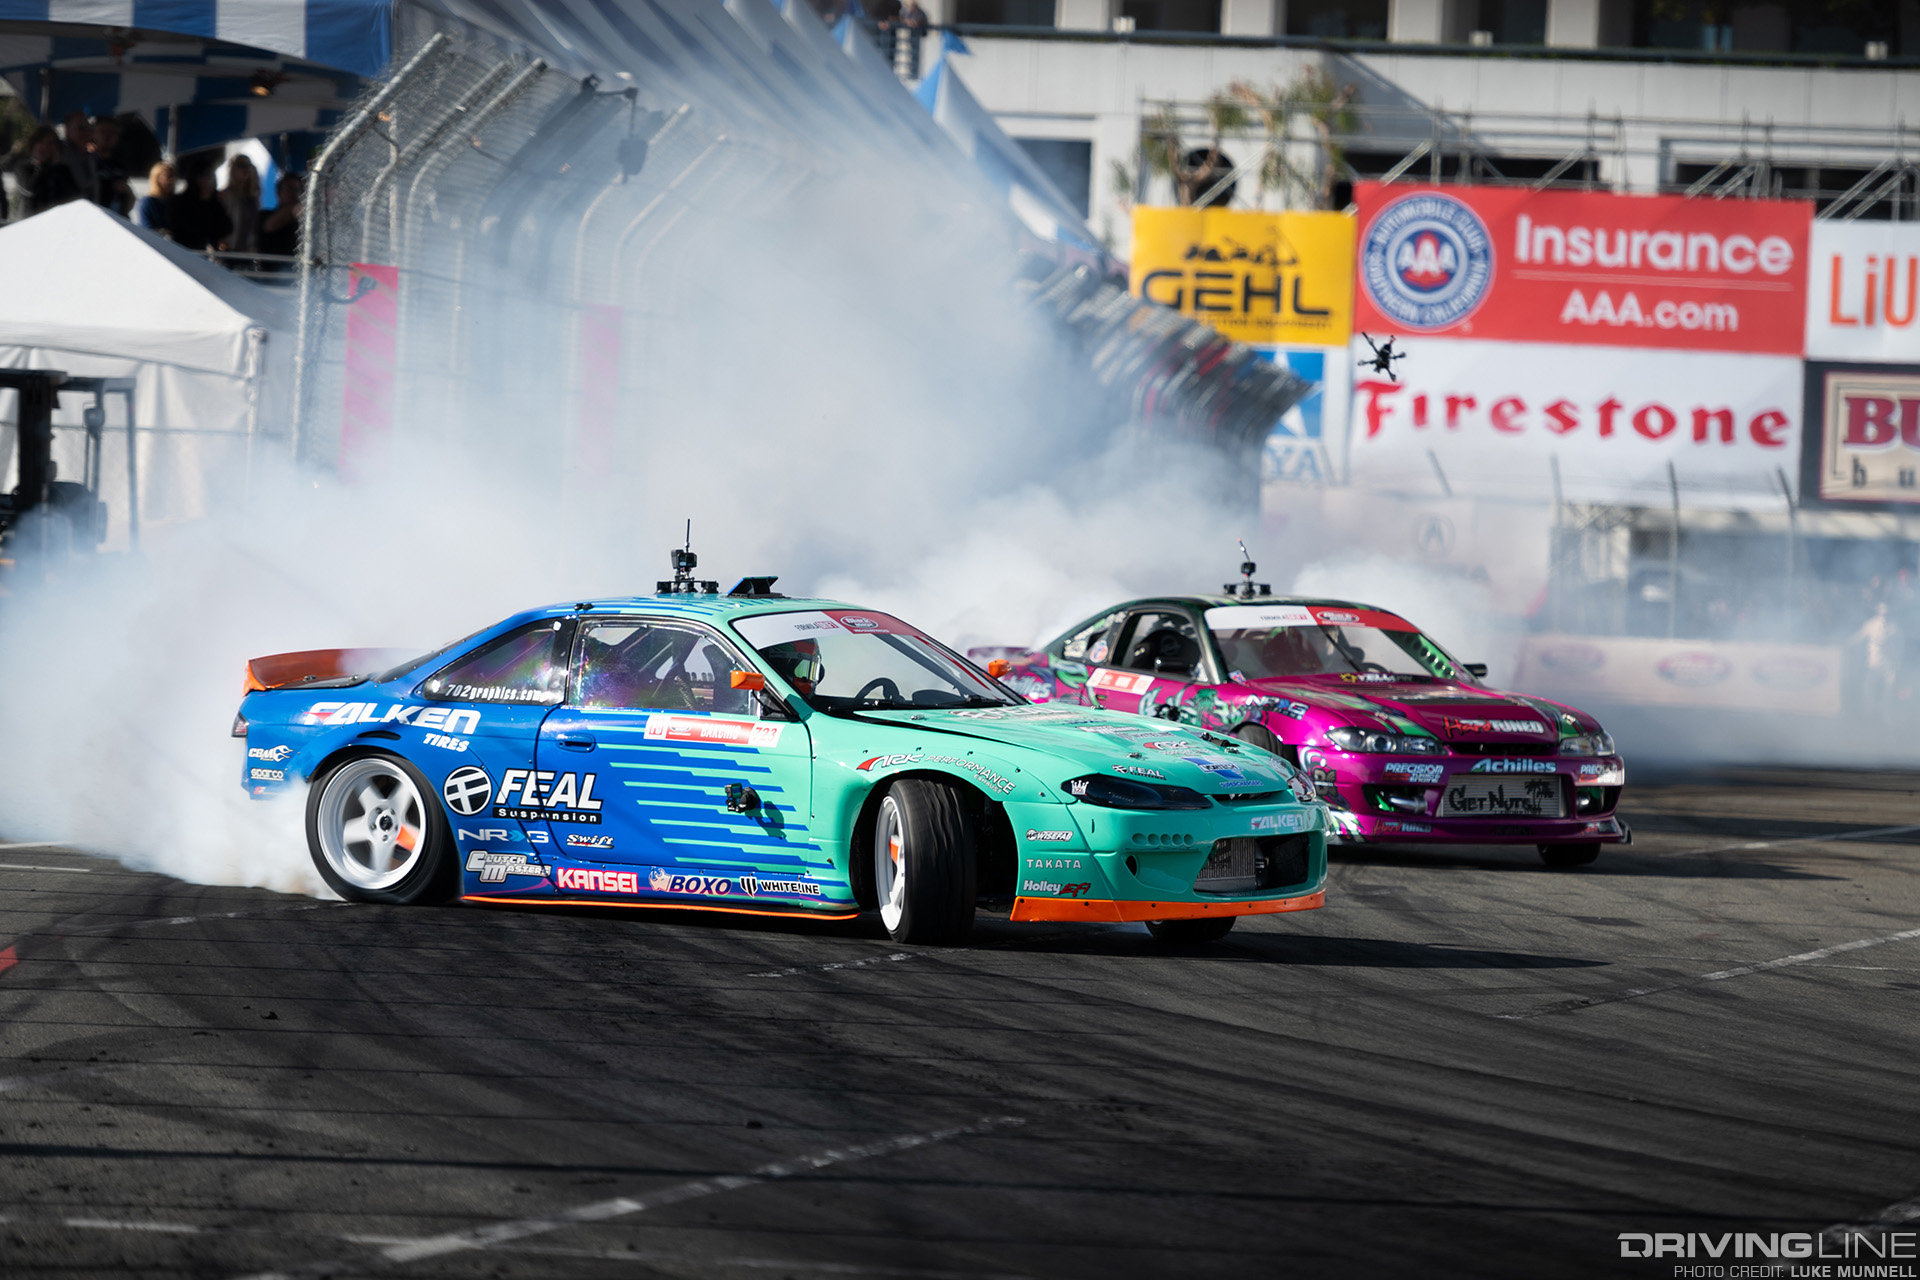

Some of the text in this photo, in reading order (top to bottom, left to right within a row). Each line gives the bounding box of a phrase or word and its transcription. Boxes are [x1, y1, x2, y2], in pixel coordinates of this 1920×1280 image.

[1515, 213, 1795, 275] Insurance
[1397, 238, 1457, 277] AAA
[1142, 270, 1330, 317] GEHL
[1560, 289, 1739, 332] AAA.com
[1355, 380, 1790, 448] Firestone
[303, 701, 481, 735] FALKEN
[423, 733, 470, 752] TIRES
[753, 726, 778, 741] 723
[251, 767, 284, 779] sparco
[857, 754, 1016, 795] ARK PERFORMANCE
[1129, 766, 1164, 778] FEAL
[1384, 762, 1444, 775] PRECISION
[1469, 758, 1556, 773] Achilles
[494, 768, 604, 811] FEAL
[1250, 814, 1303, 830] FALKEN
[566, 834, 615, 846] Swift
[467, 852, 526, 870] CLUTCH
[1026, 859, 1081, 869] TAKATA
[480, 864, 551, 882] MASTERS
[558, 868, 638, 893] KANSEI
[670, 876, 732, 895] BOXO
[760, 880, 820, 896] WHITELINE
[1023, 880, 1061, 895] Holley
